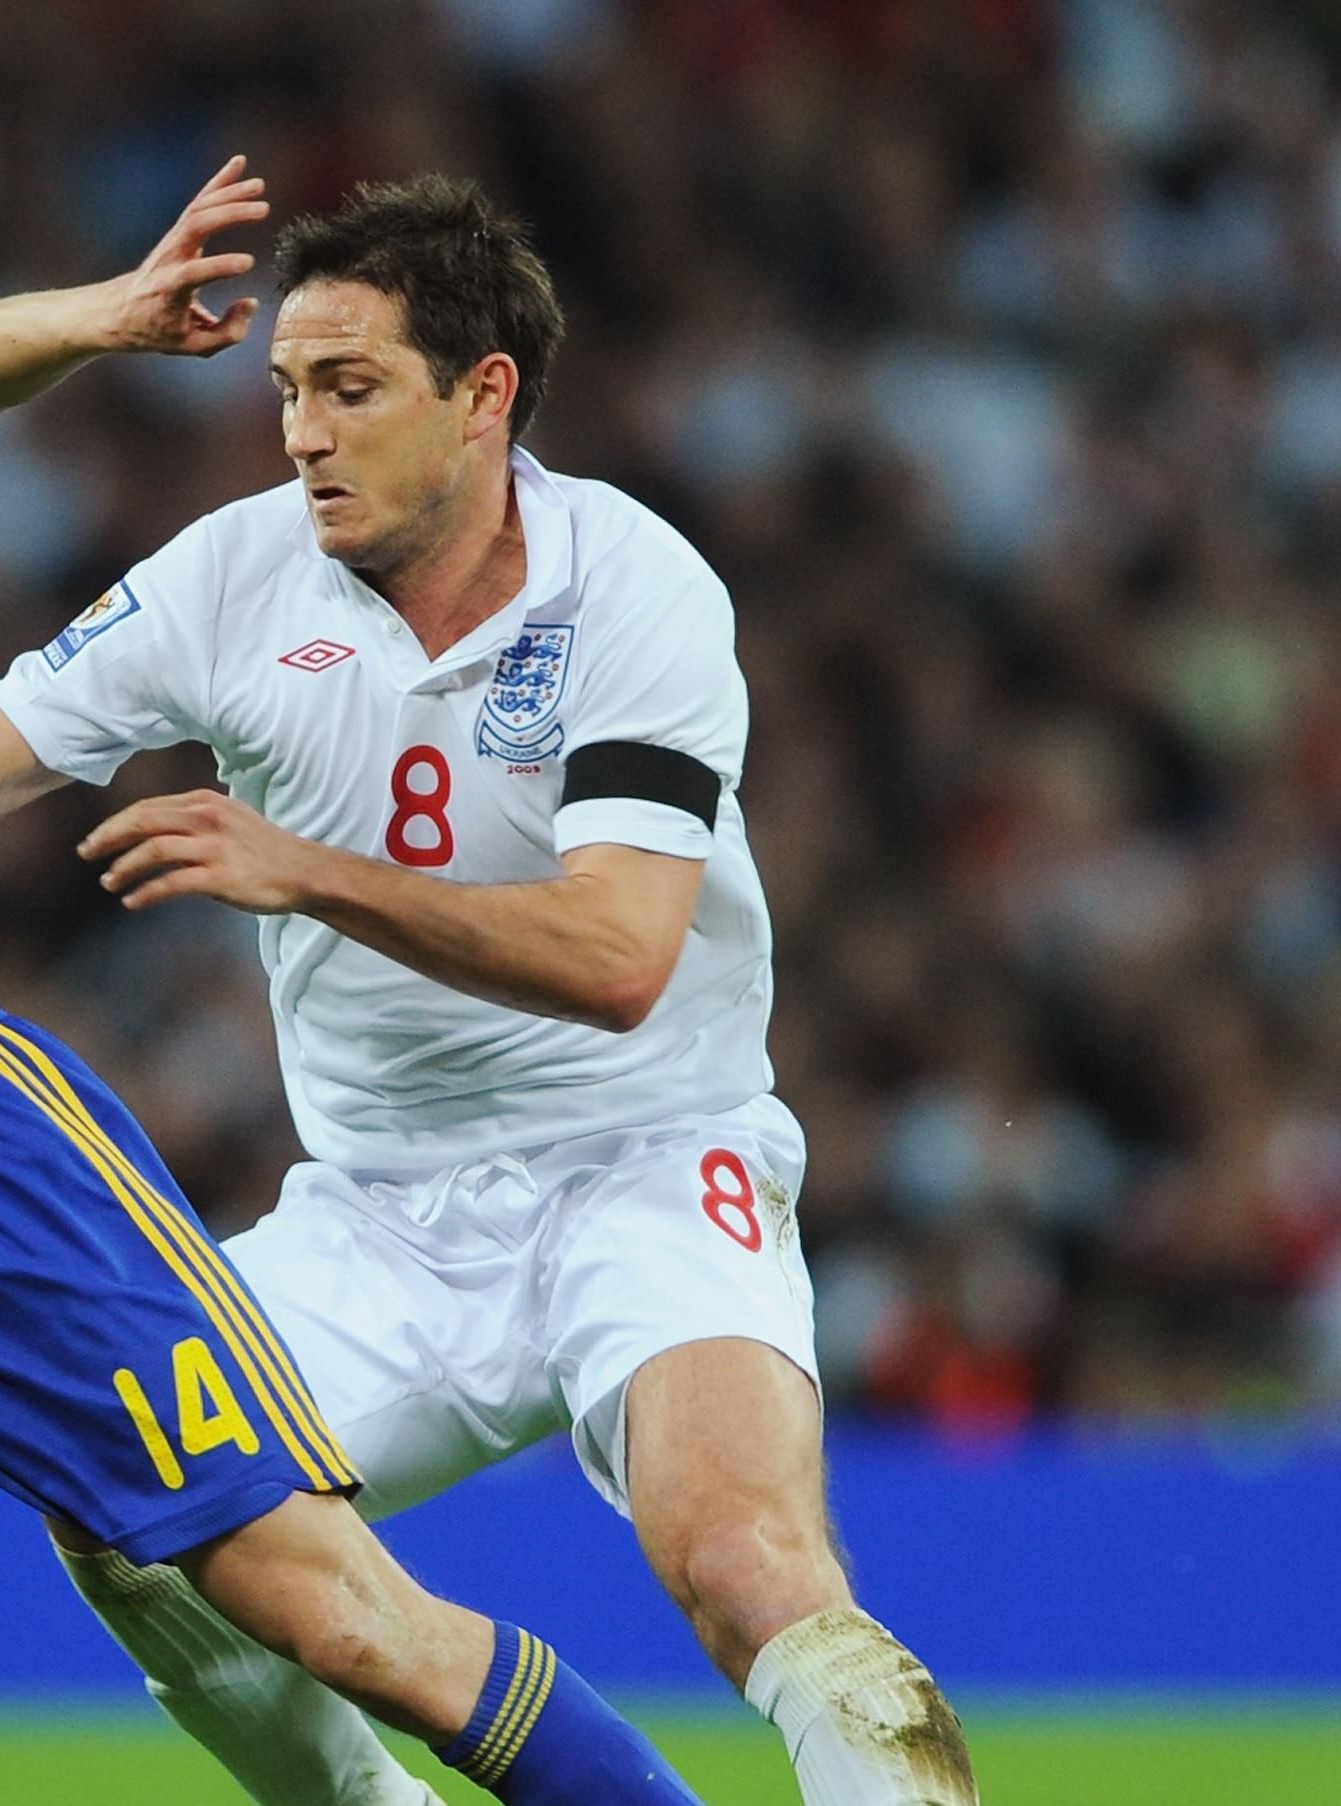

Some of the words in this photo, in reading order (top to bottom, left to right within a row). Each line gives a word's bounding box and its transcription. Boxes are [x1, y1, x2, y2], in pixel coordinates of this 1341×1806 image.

[386, 744, 454, 866] 8
[700, 1147, 762, 1253] 8
[112, 1336, 260, 1490] 14
